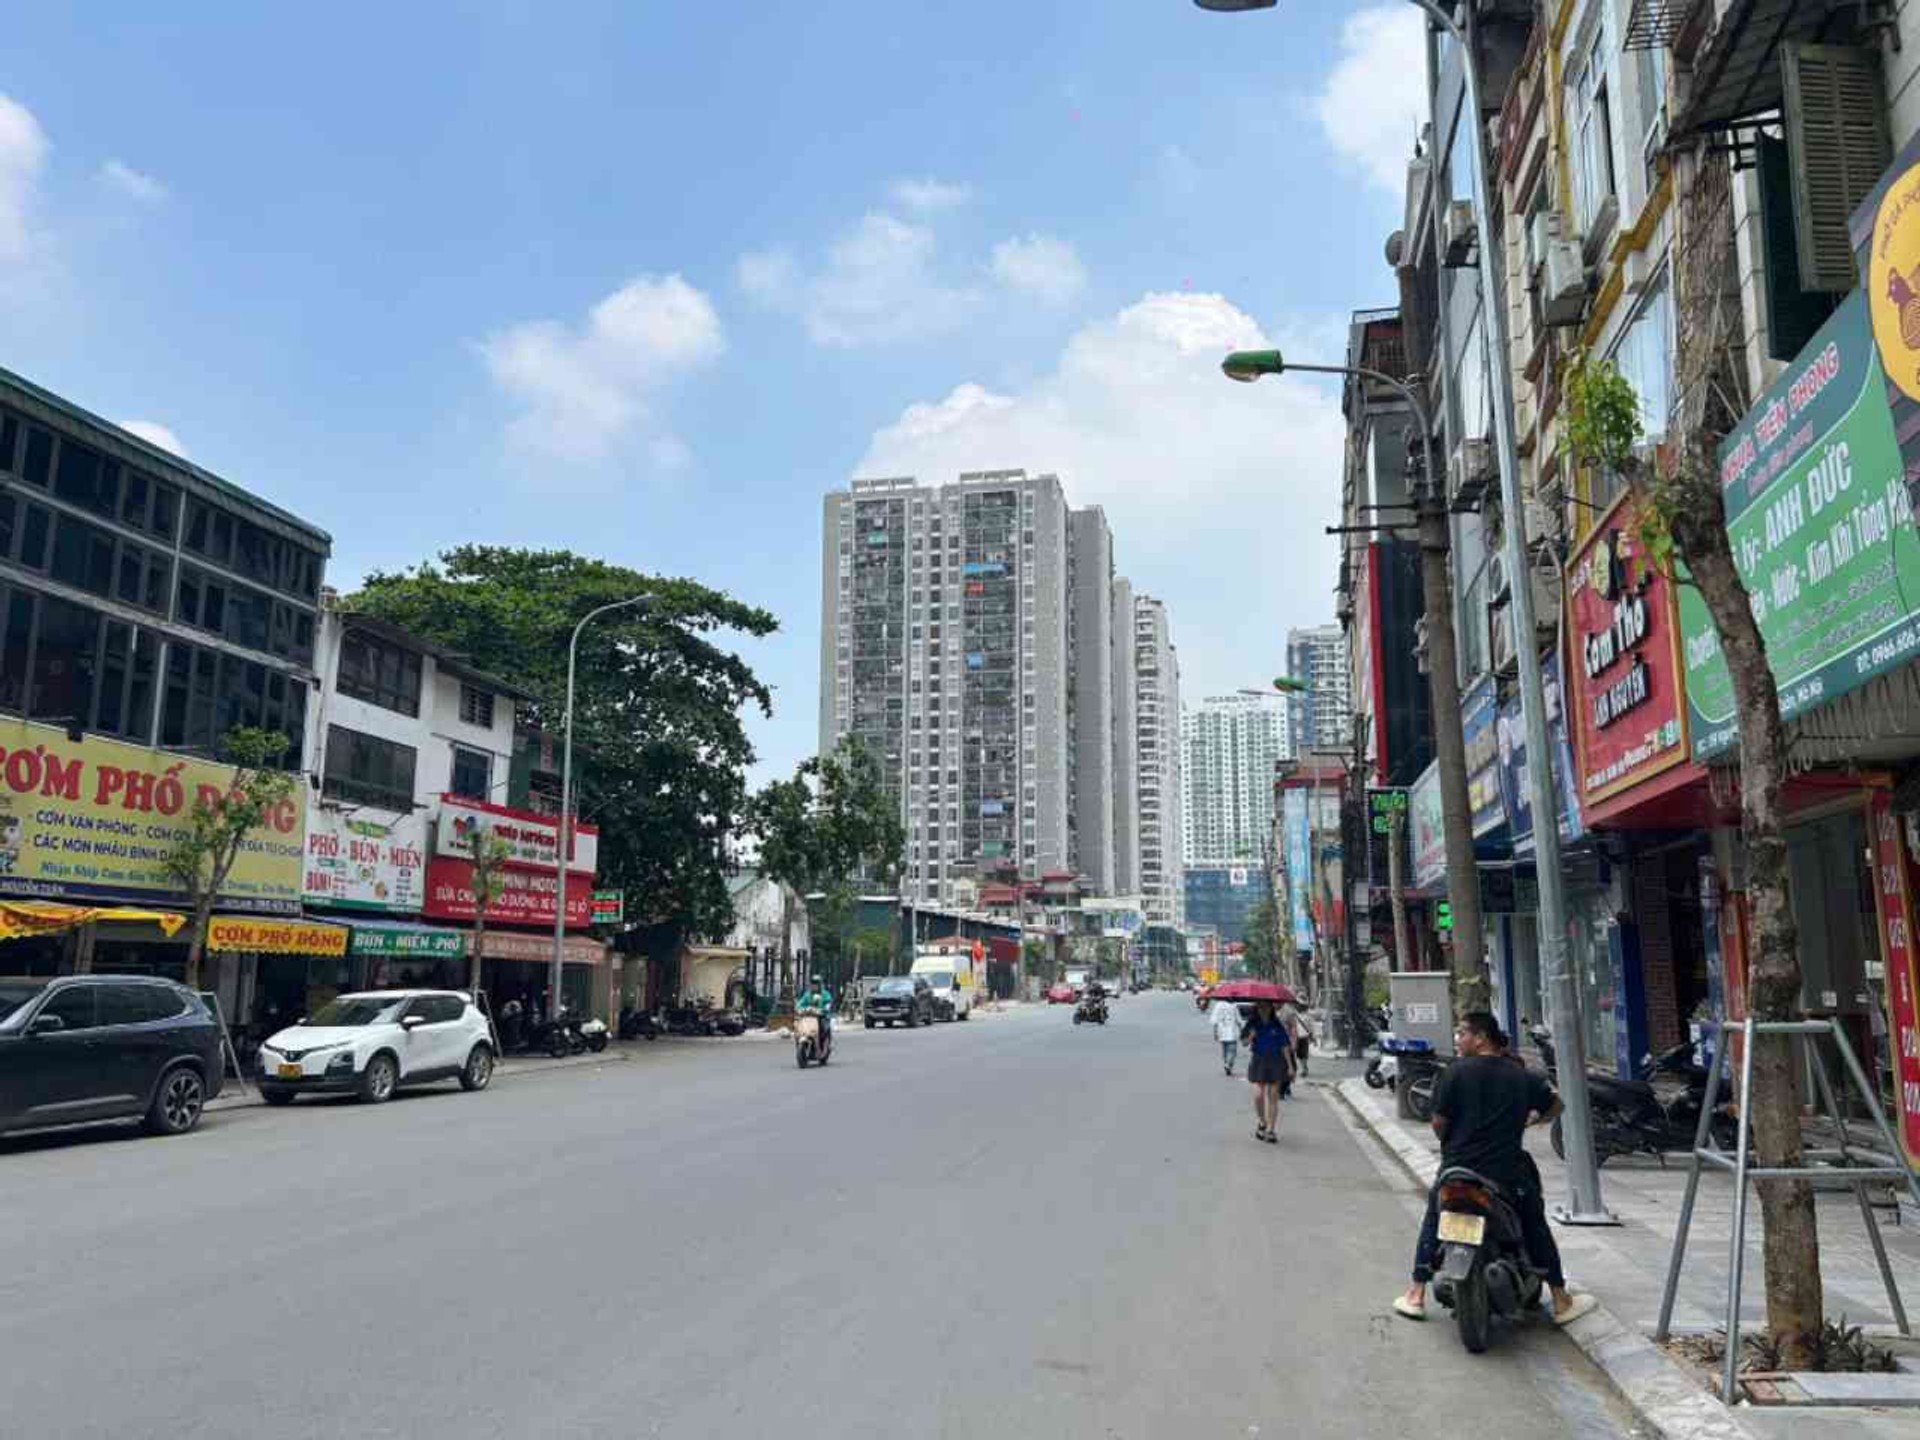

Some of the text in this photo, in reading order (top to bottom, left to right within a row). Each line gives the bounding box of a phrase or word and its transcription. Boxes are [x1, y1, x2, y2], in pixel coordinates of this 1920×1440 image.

[1765, 482, 1804, 553] ANH
[1807, 441, 1852, 517] ĐỨC
[0, 743, 84, 801] ƠM
[93, 760, 188, 817] PHỐ
[212, 924, 252, 942] CƠM
